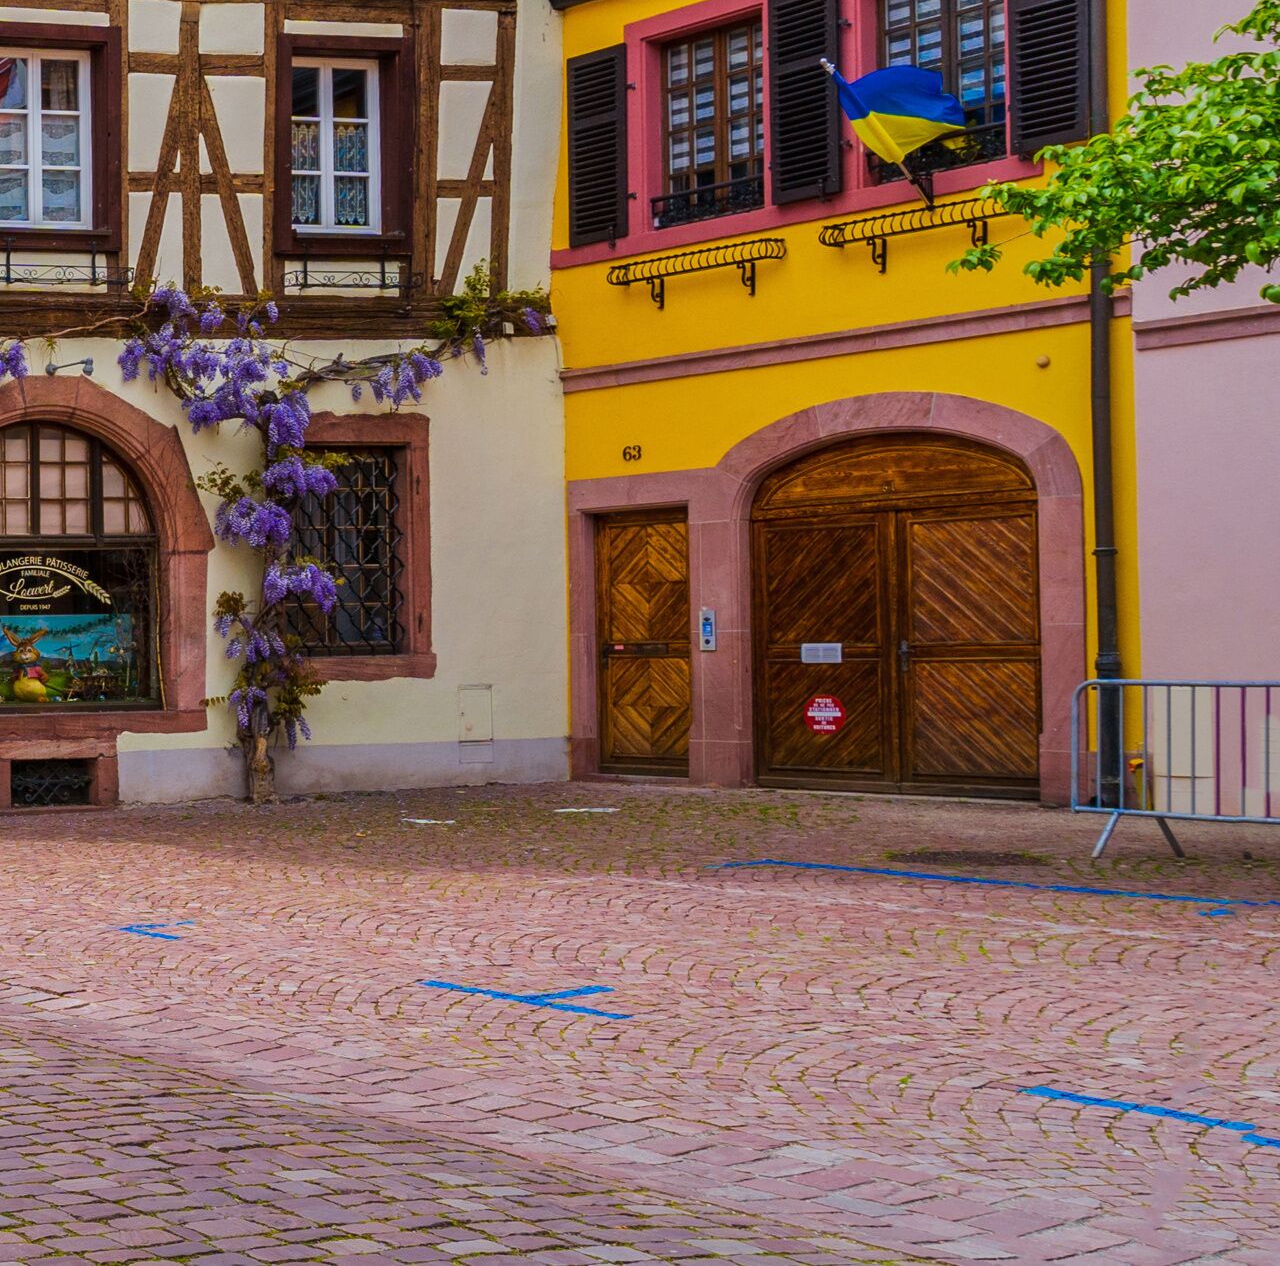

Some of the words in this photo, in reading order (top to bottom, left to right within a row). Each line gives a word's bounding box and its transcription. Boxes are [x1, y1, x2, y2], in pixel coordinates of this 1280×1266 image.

[623, 445, 642, 462] 63
[20, 569, 51, 578] FAMILIALE
[5, 578, 54, 602] Loewert
